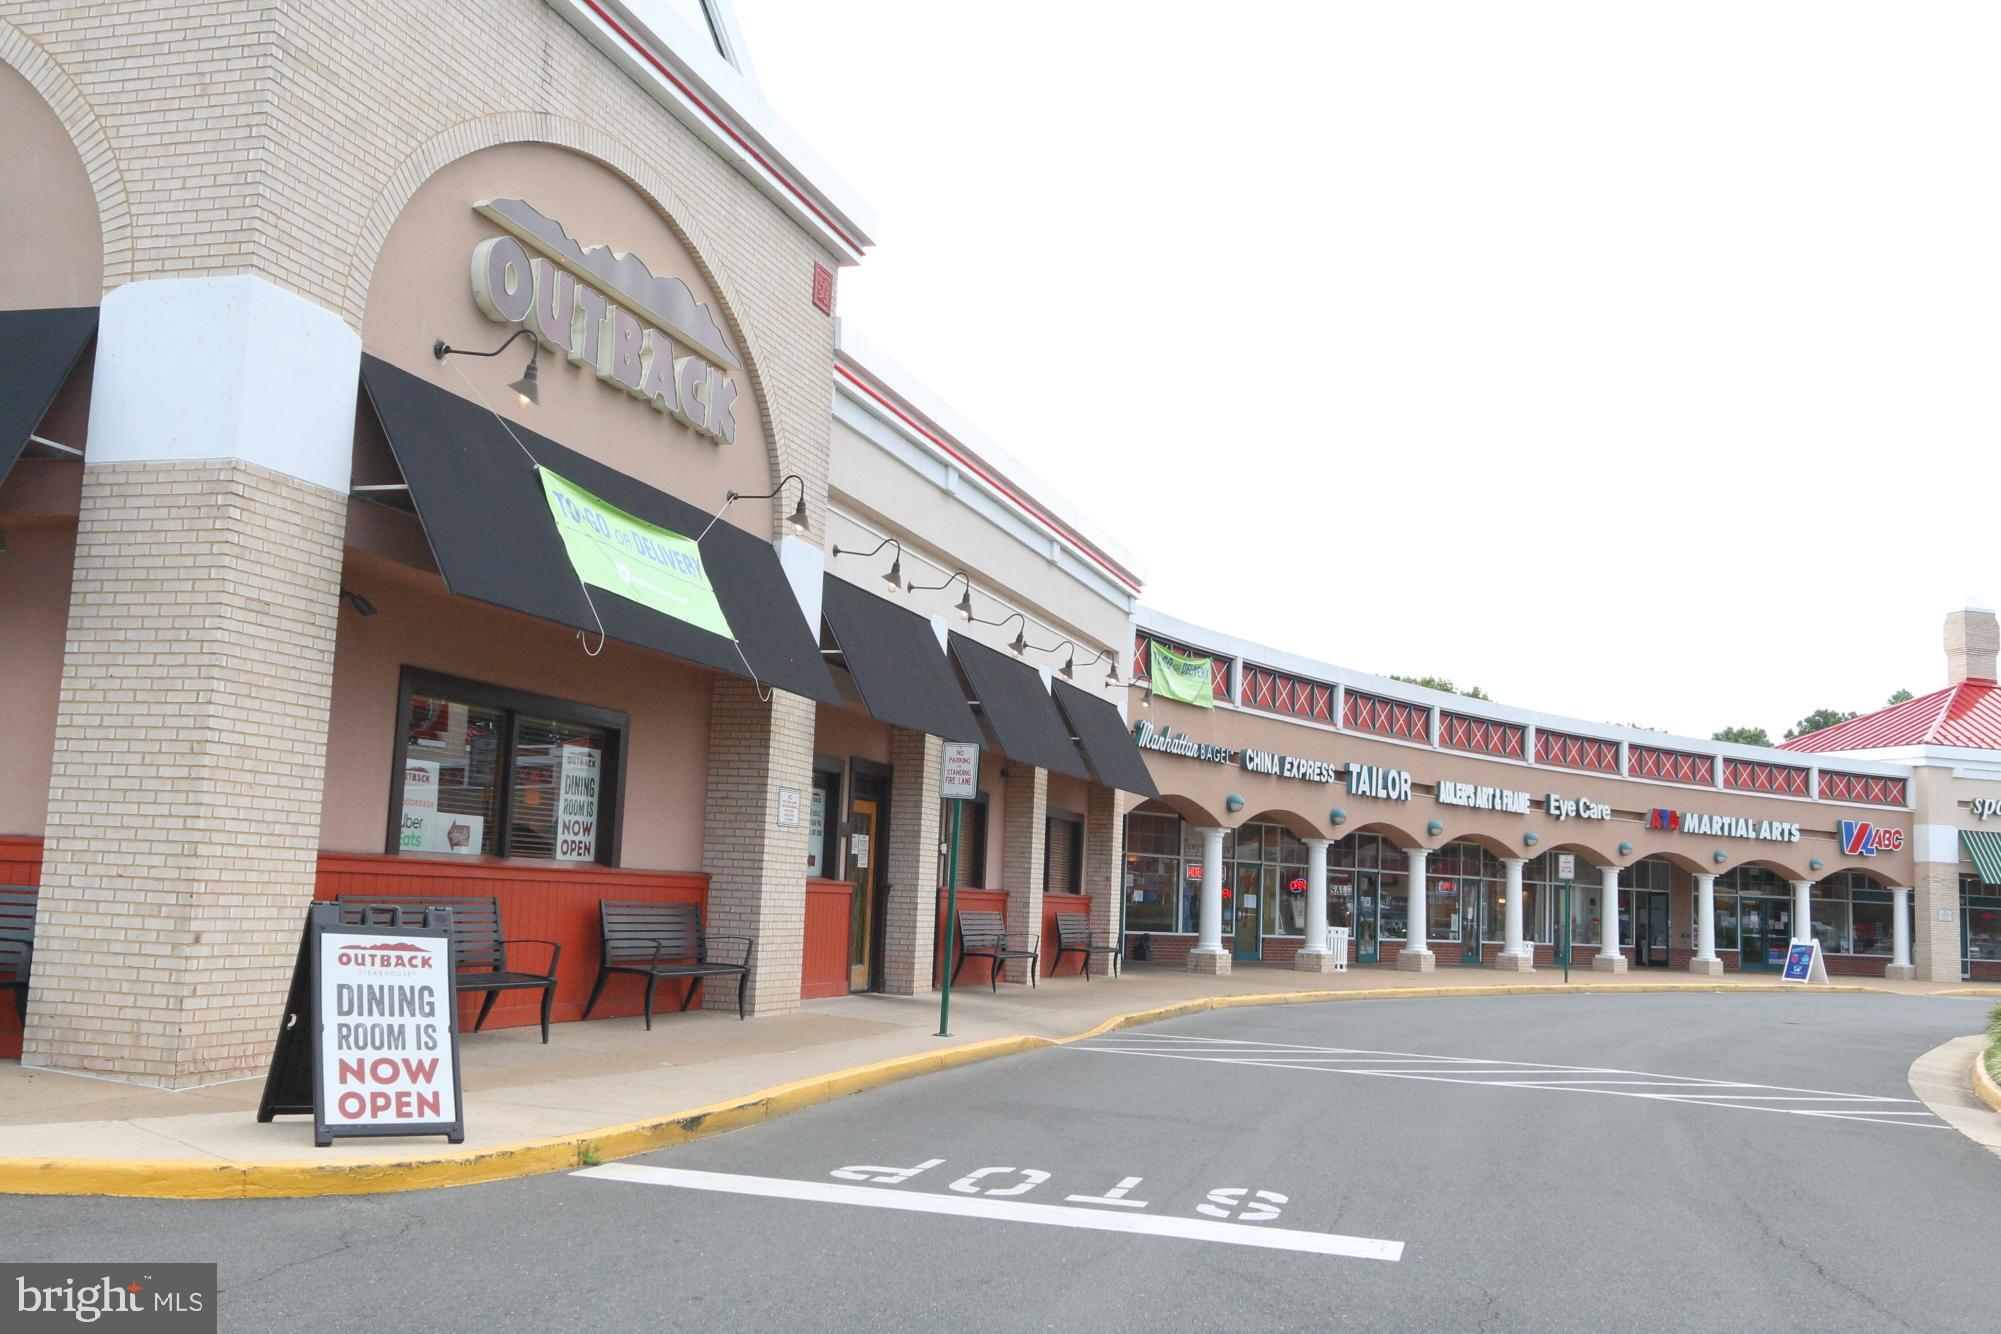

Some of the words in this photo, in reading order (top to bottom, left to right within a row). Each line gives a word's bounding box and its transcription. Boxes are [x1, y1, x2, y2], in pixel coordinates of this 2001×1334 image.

[471, 236, 738, 445] OUTBACK
[552, 490, 612, 539] TO-GO
[630, 530, 704, 581] DELIVERY
[1138, 720, 1199, 758] Manhattan
[1200, 749, 1230, 765] BAGEL
[946, 769, 972, 777] STANDING
[948, 756, 972, 765] PARKING
[1245, 749, 1281, 776] CHINA
[1283, 756, 1335, 783] EXPRESS
[564, 774, 596, 798] DINING
[958, 777, 972, 786] LANE
[1349, 762, 1413, 800] TAILOR
[563, 798, 585, 817] ROOM
[586, 801, 594, 818] IS
[1439, 780, 1476, 807] ADLER'S
[1476, 786, 1494, 809] ART
[1494, 788, 1502, 810] &
[1502, 790, 1531, 814] FRAME
[1549, 793, 1576, 820] Eye
[1578, 797, 1612, 820] Care
[561, 820, 593, 837] NOW
[1683, 812, 1756, 840] MARTIAL
[1758, 822, 1800, 842] ARTS
[1870, 828, 1904, 851] ABC
[560, 839, 592, 857] OPEN
[338, 952, 432, 969] OUTBACK
[336, 983, 436, 1018] DINING
[337, 1022, 406, 1051] ROOM
[416, 1023, 438, 1051] IS
[338, 1057, 440, 1085] NOW
[337, 1090, 441, 1120] OPEN
[830, 1158, 1289, 1221] STOP
